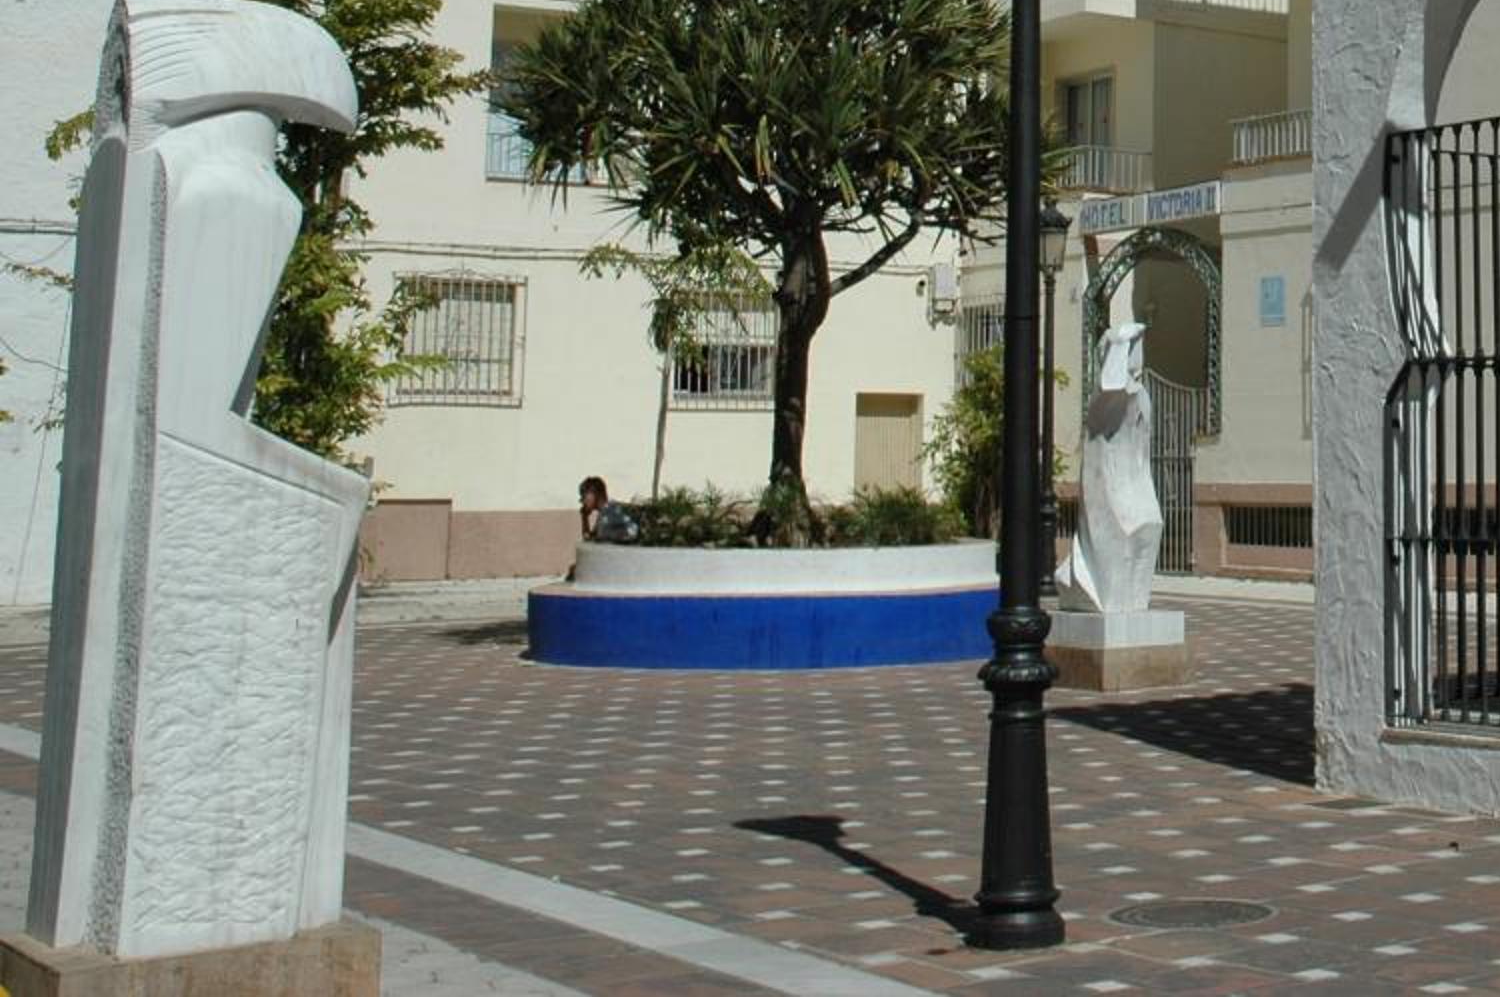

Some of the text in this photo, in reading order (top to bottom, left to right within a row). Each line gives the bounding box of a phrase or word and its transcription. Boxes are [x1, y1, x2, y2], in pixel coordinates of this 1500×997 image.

[1080, 186, 1216, 229] HOTEL VICTORIA II
